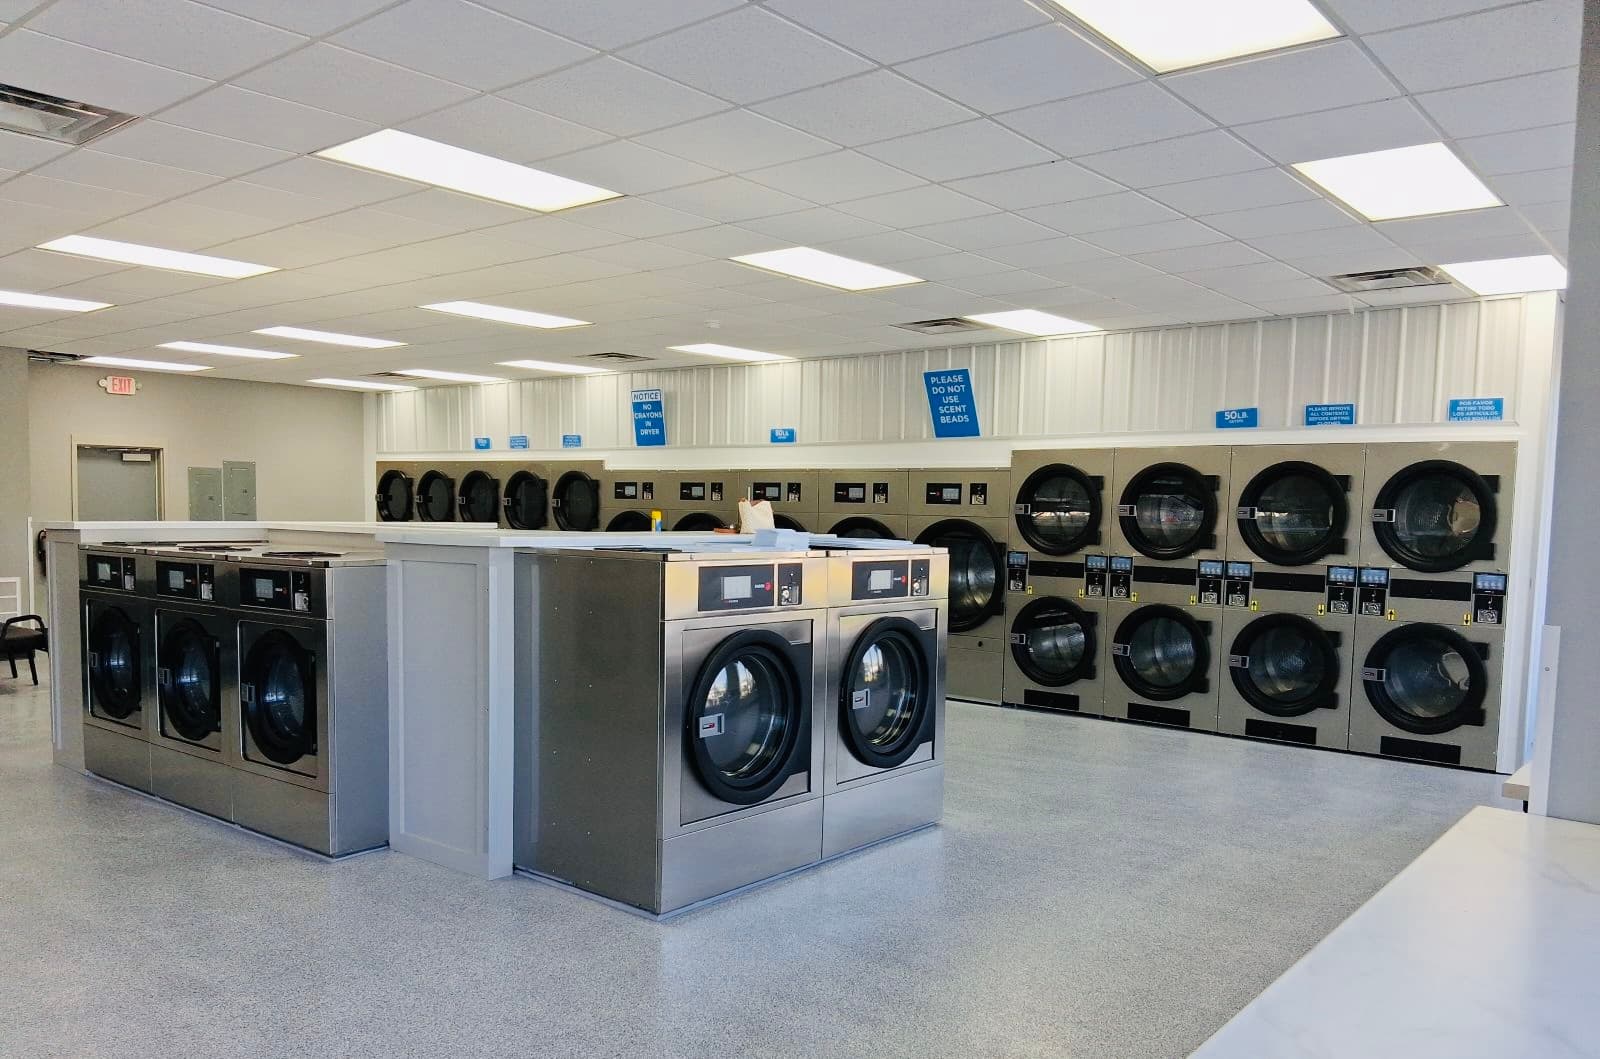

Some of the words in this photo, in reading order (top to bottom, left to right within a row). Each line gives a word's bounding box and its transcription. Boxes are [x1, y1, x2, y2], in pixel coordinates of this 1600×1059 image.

[930, 374, 964, 384] PLEASE
[112, 377, 132, 393] EXIT
[932, 386, 945, 394] DO
[947, 384, 966, 393] NOT
[633, 392, 660, 400] NOTICE
[942, 396, 960, 404] USE
[938, 405, 967, 414] SCENT
[940, 415, 970, 424] BEADS
